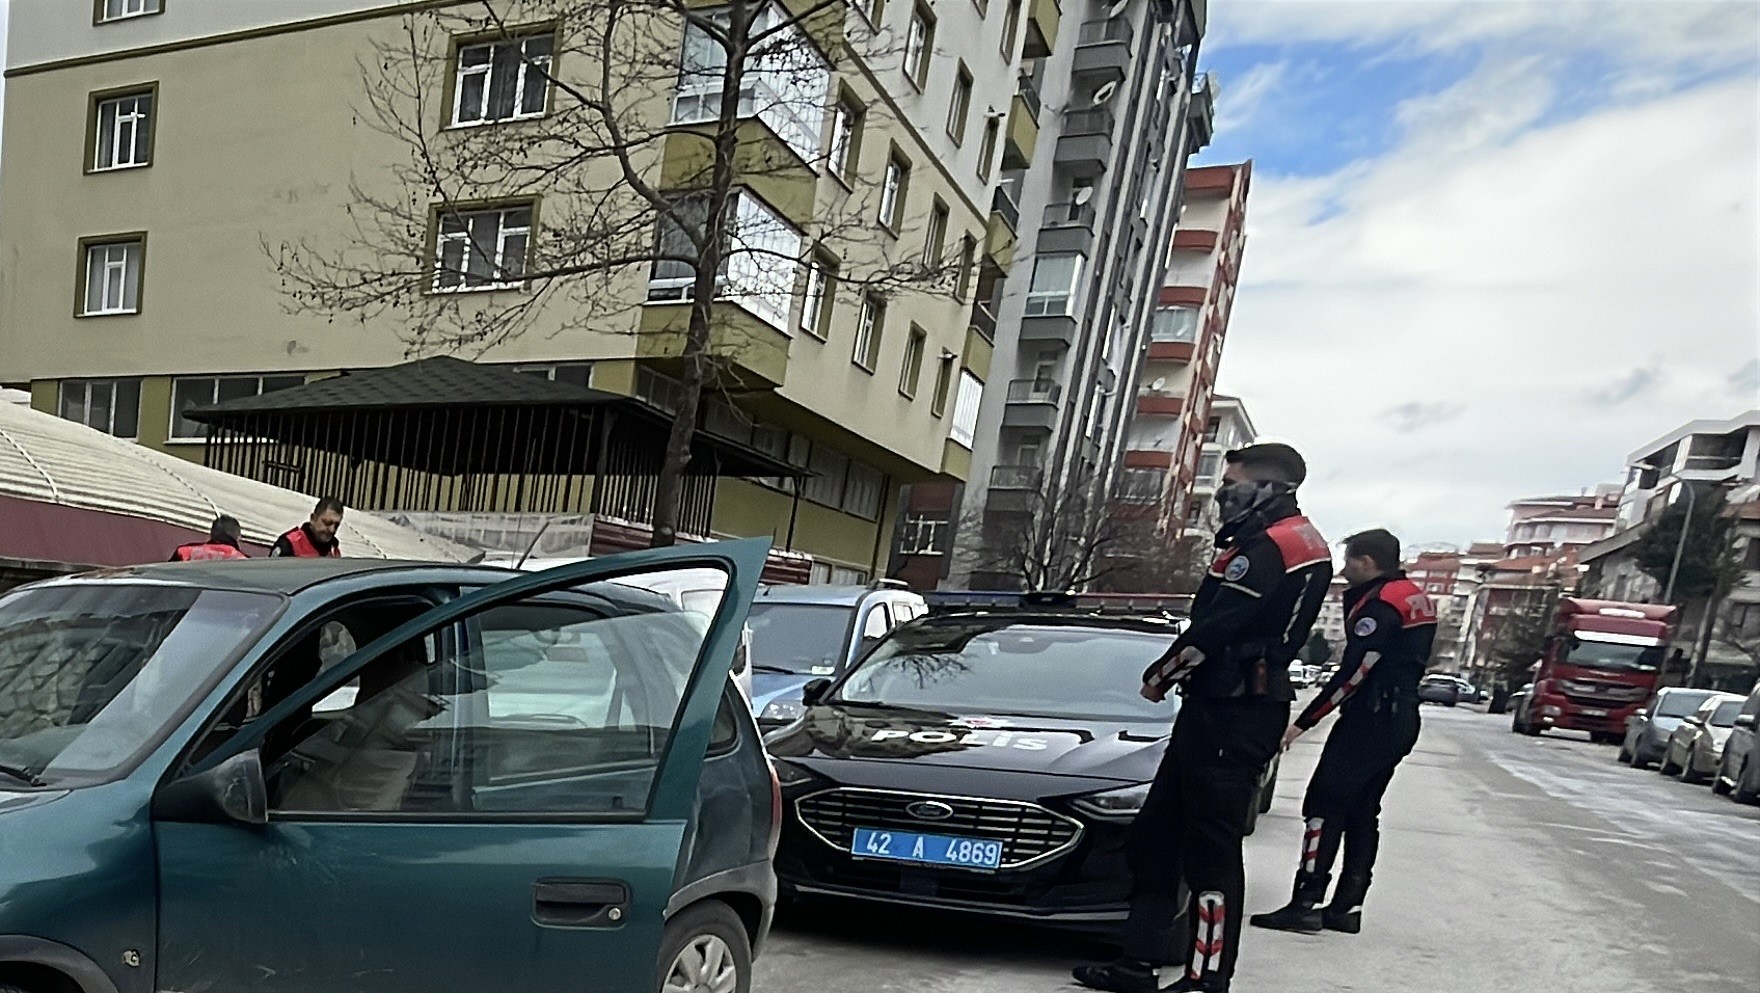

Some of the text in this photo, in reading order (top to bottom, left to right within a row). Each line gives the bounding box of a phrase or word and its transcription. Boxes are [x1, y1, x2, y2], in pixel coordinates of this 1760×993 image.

[866, 832, 998, 865] 42 A 4869
